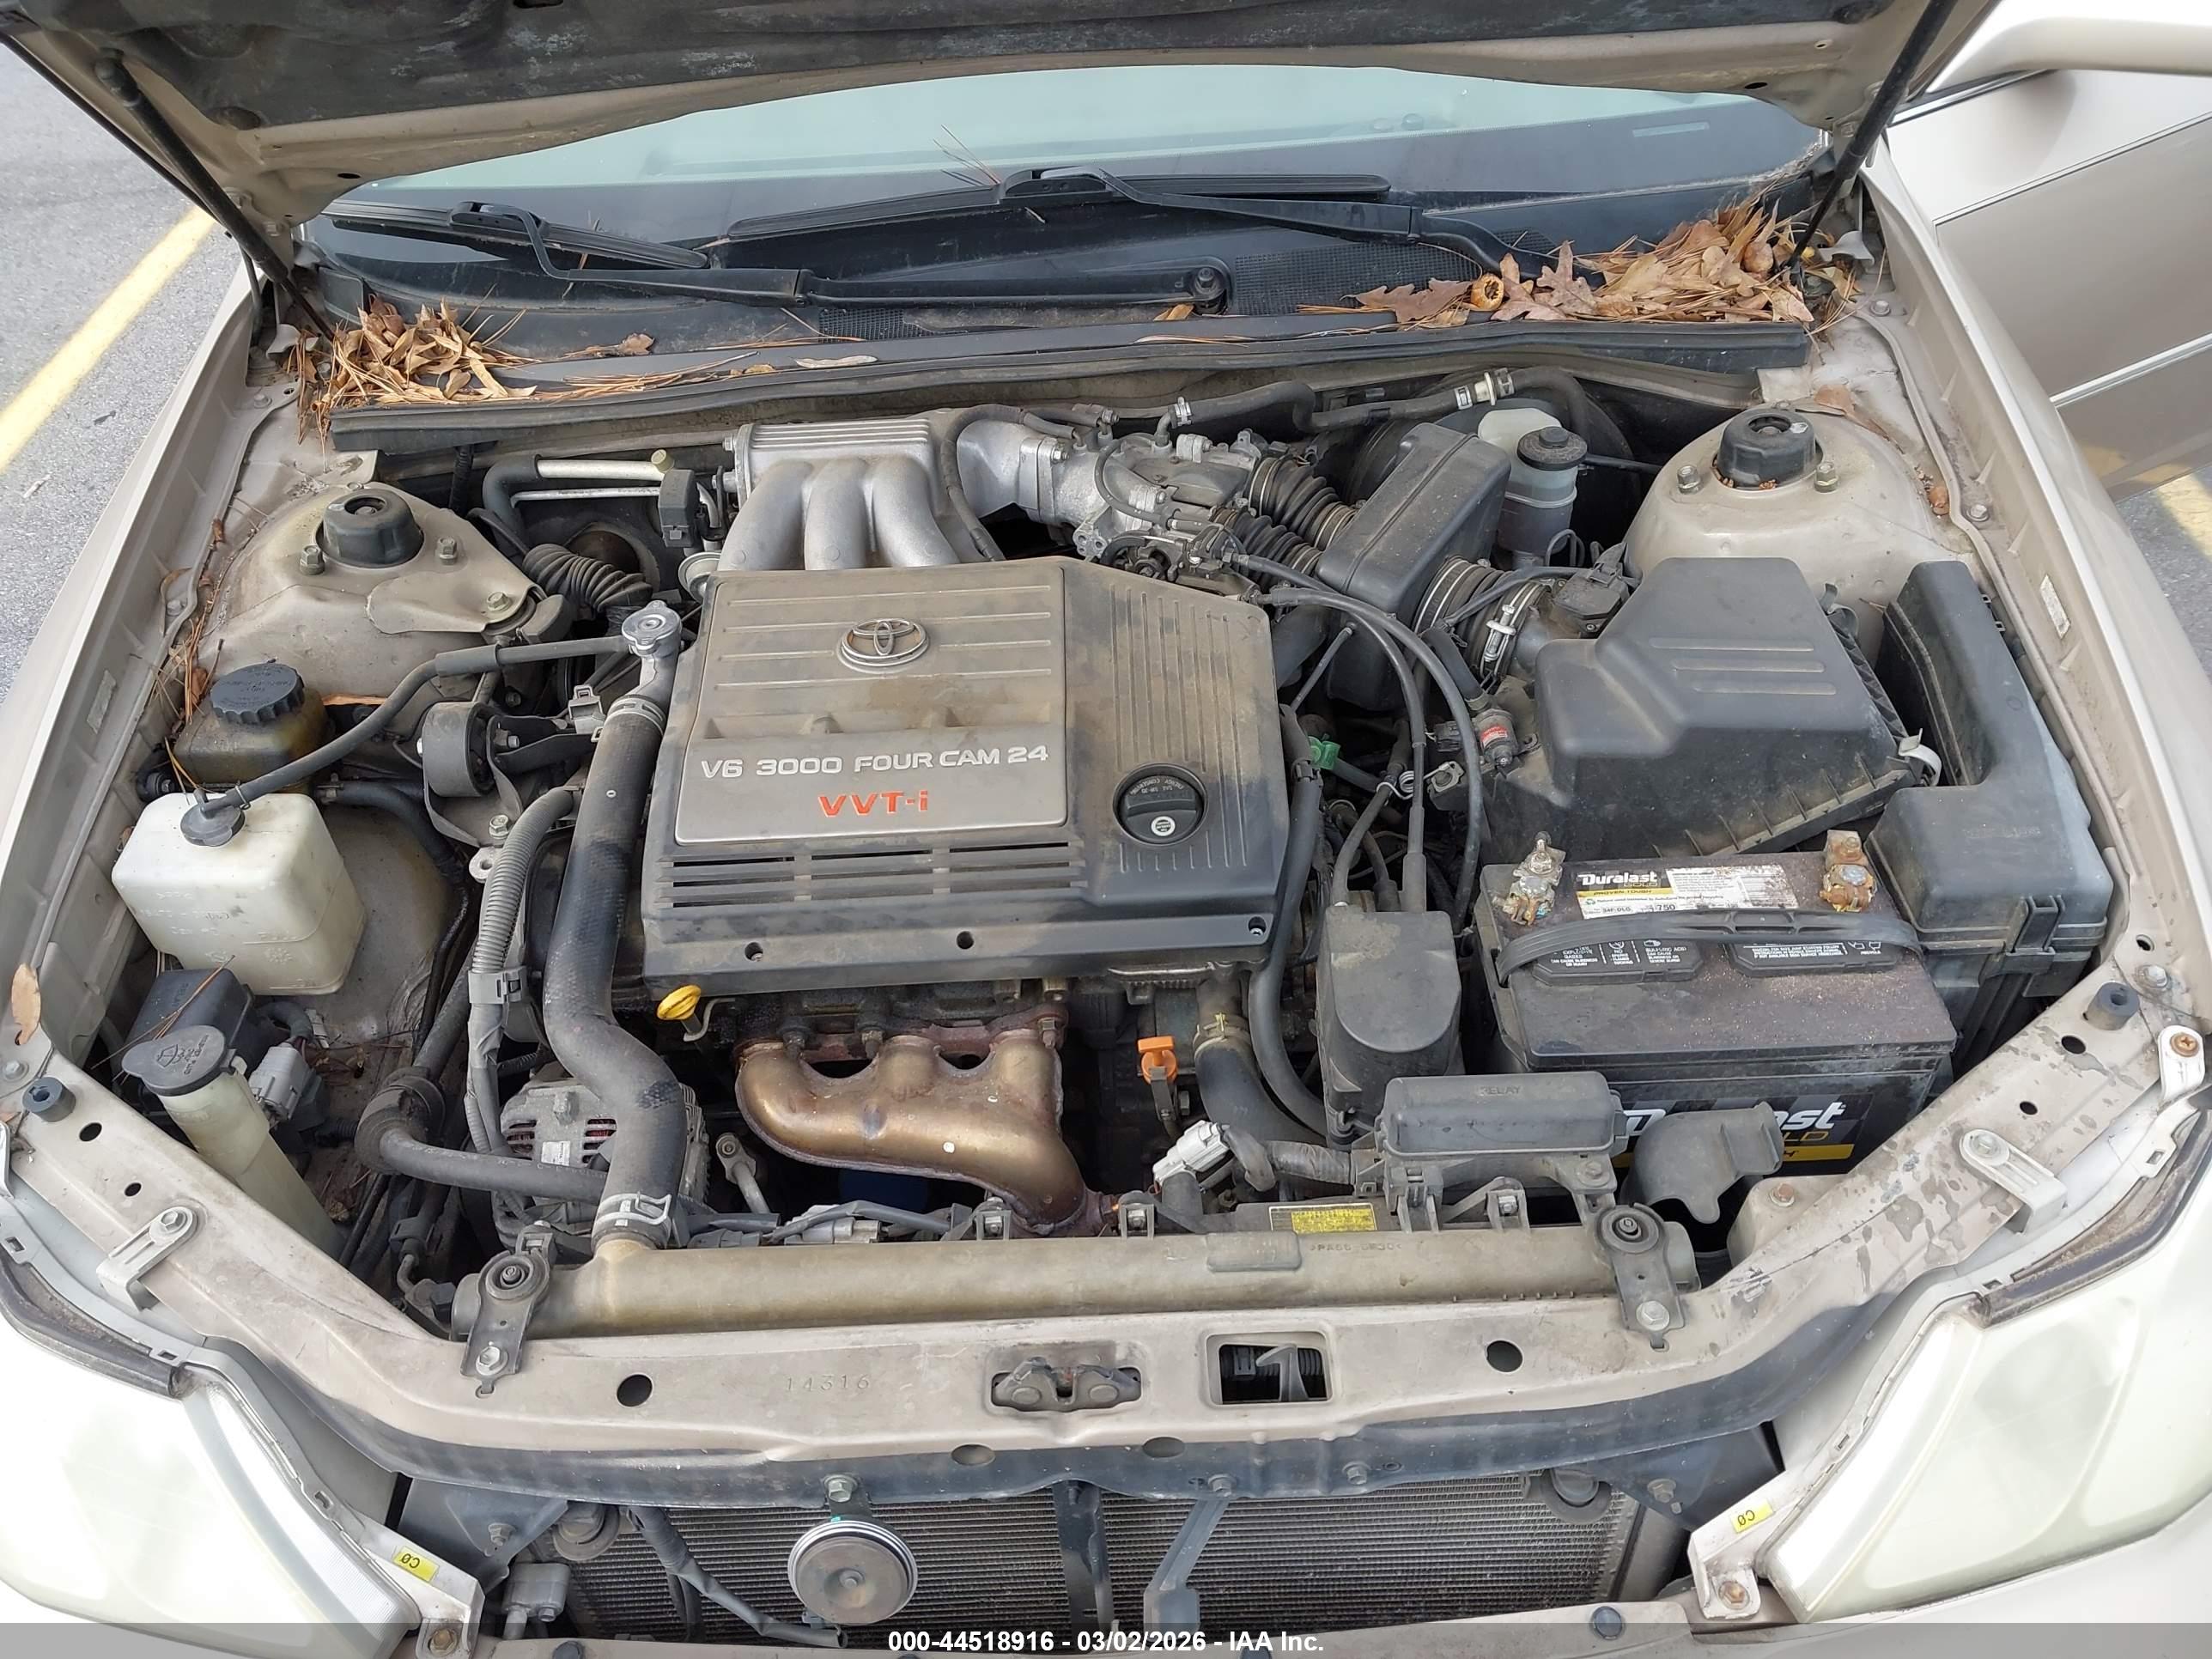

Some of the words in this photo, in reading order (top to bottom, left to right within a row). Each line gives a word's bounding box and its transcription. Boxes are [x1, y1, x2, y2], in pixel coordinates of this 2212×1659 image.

[701, 759, 744, 779] V6
[756, 757, 843, 775] 3000
[854, 751, 934, 772] FOUR
[939, 748, 1000, 767] CAM
[1007, 744, 1048, 763] 24
[817, 789, 928, 817] VVT-i
[1577, 871, 1657, 886] Duralast
[1479, 1085, 1521, 1097] RELAY
[787, 1374, 870, 1392] 14316
